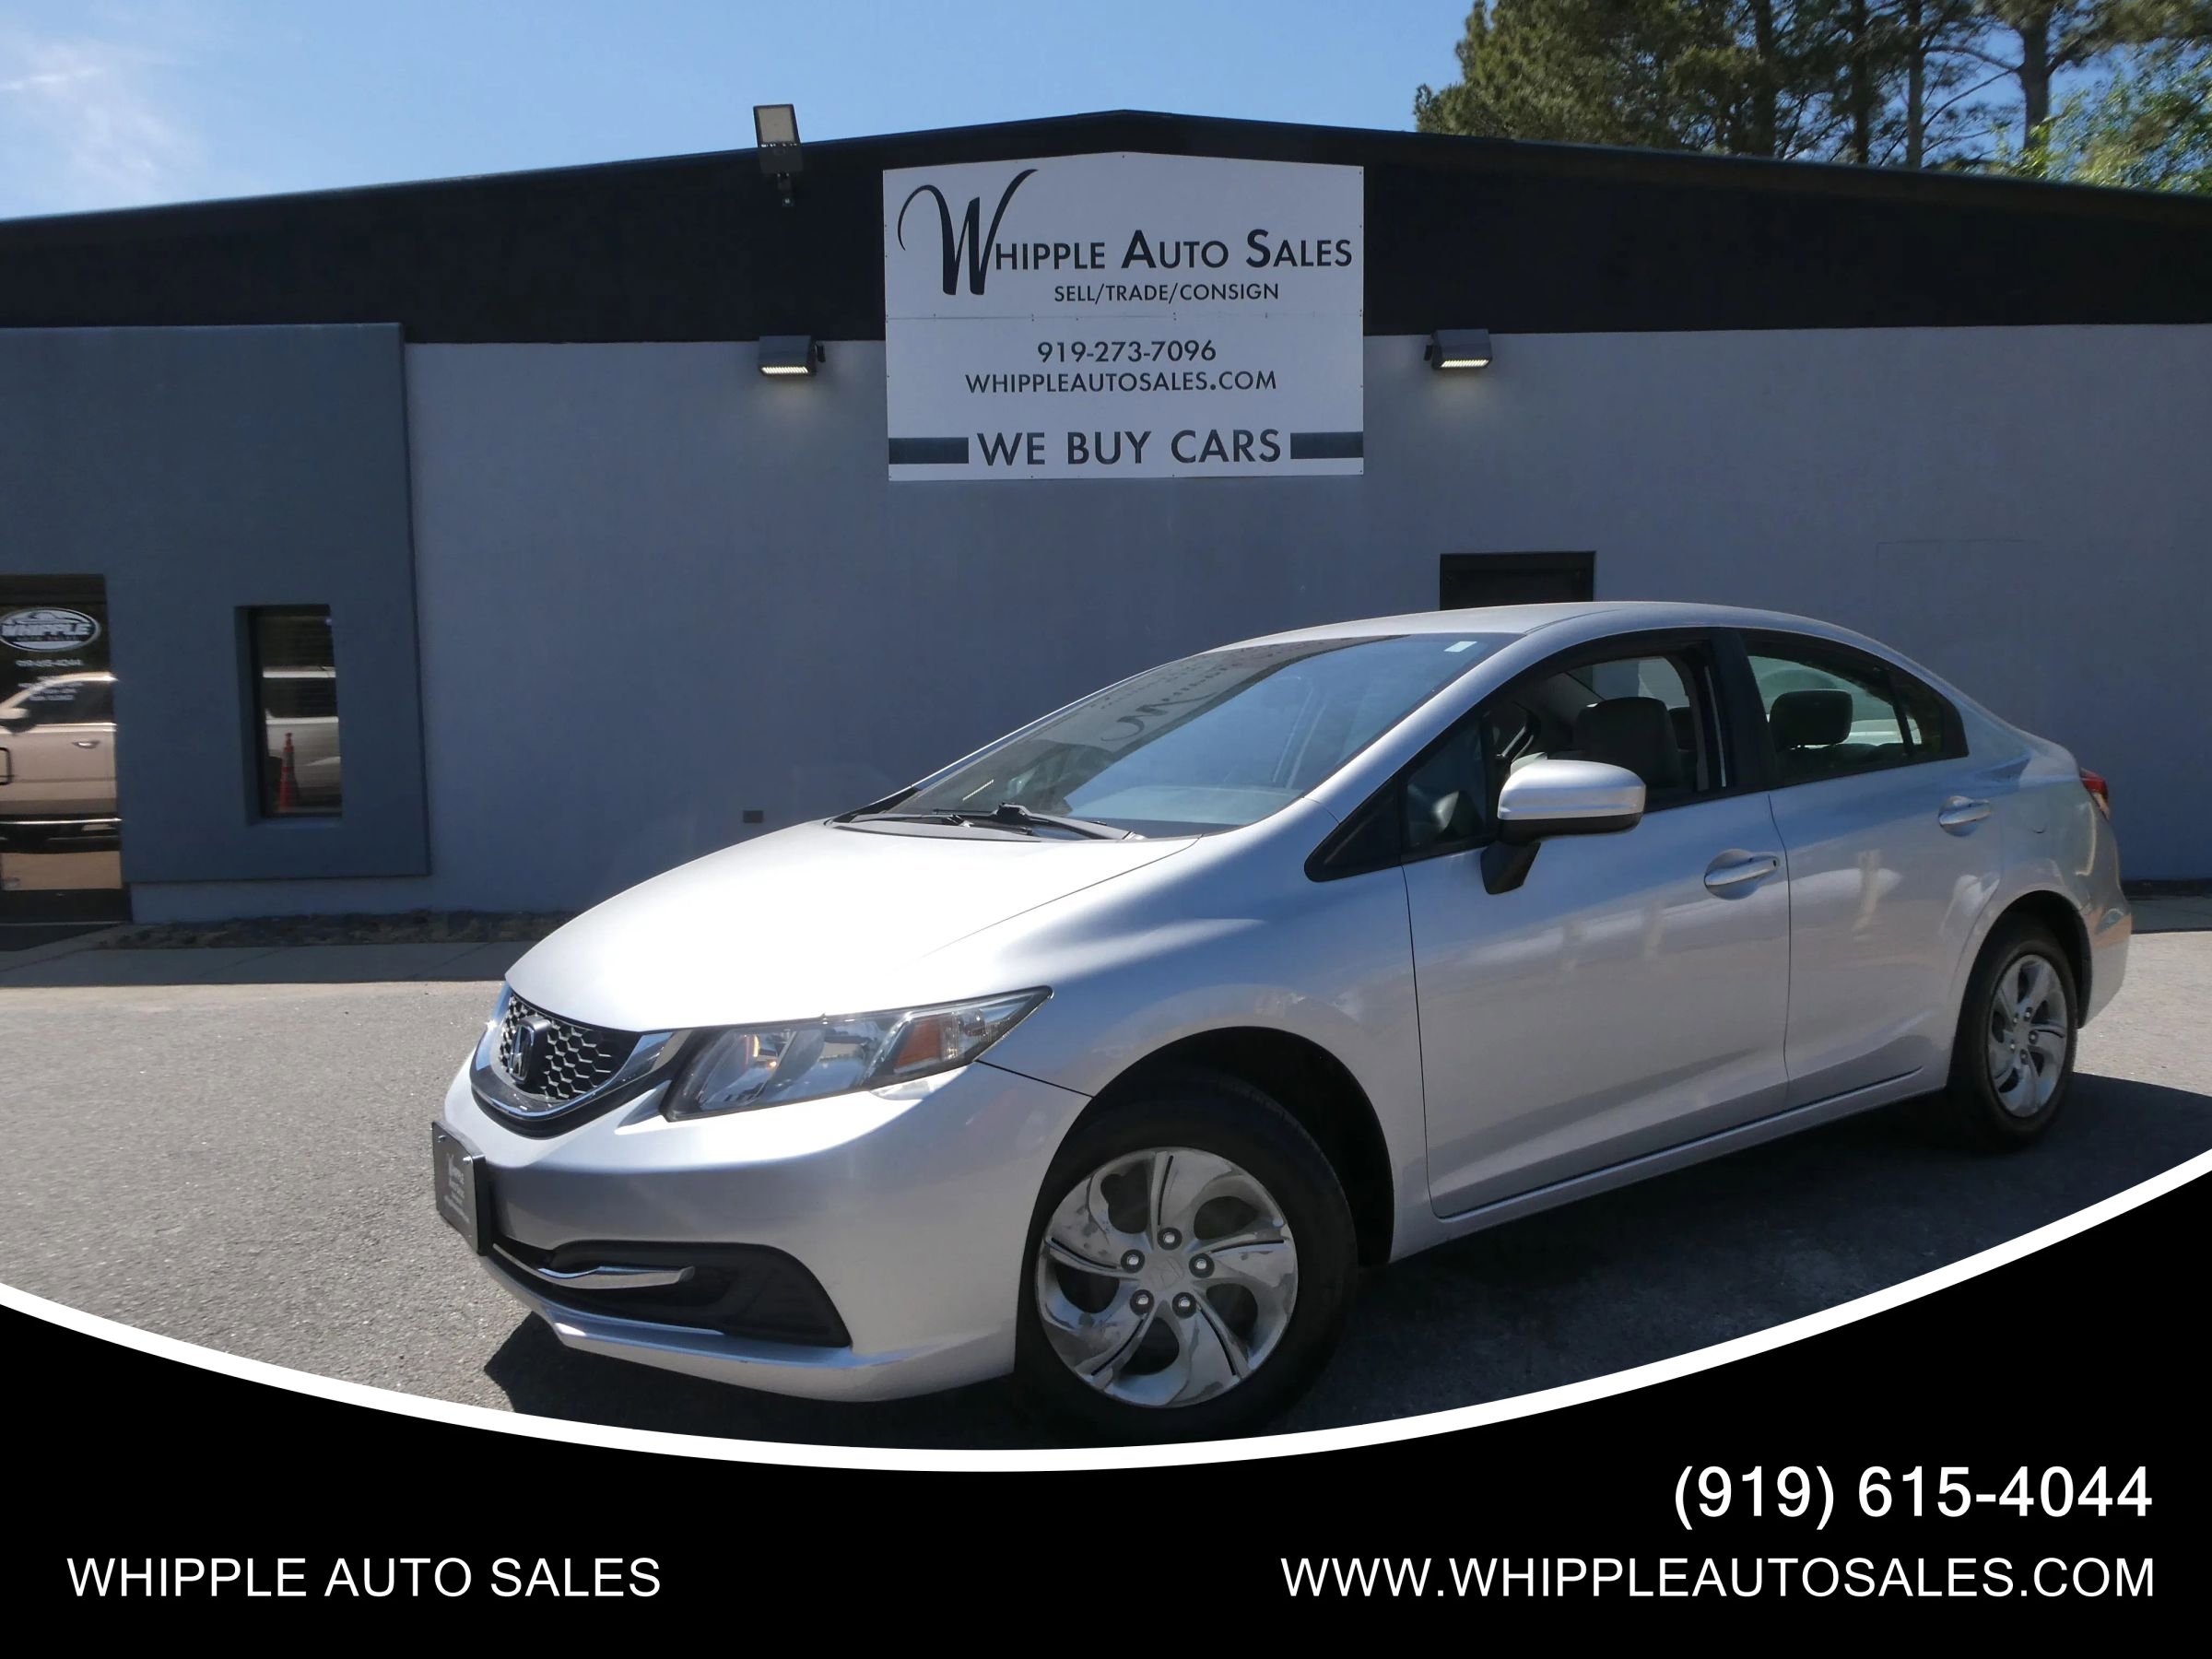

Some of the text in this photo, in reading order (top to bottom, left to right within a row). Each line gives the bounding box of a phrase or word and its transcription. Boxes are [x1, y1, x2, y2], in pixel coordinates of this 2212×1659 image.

[1054, 283, 1279, 305] SELL/TRADE/CONSIGN
[1037, 339, 1218, 363] 919-273-7096
[965, 371, 1277, 394] WHIPPLEAUTOSALES.COM
[976, 429, 1282, 466] WE BUY CARS
